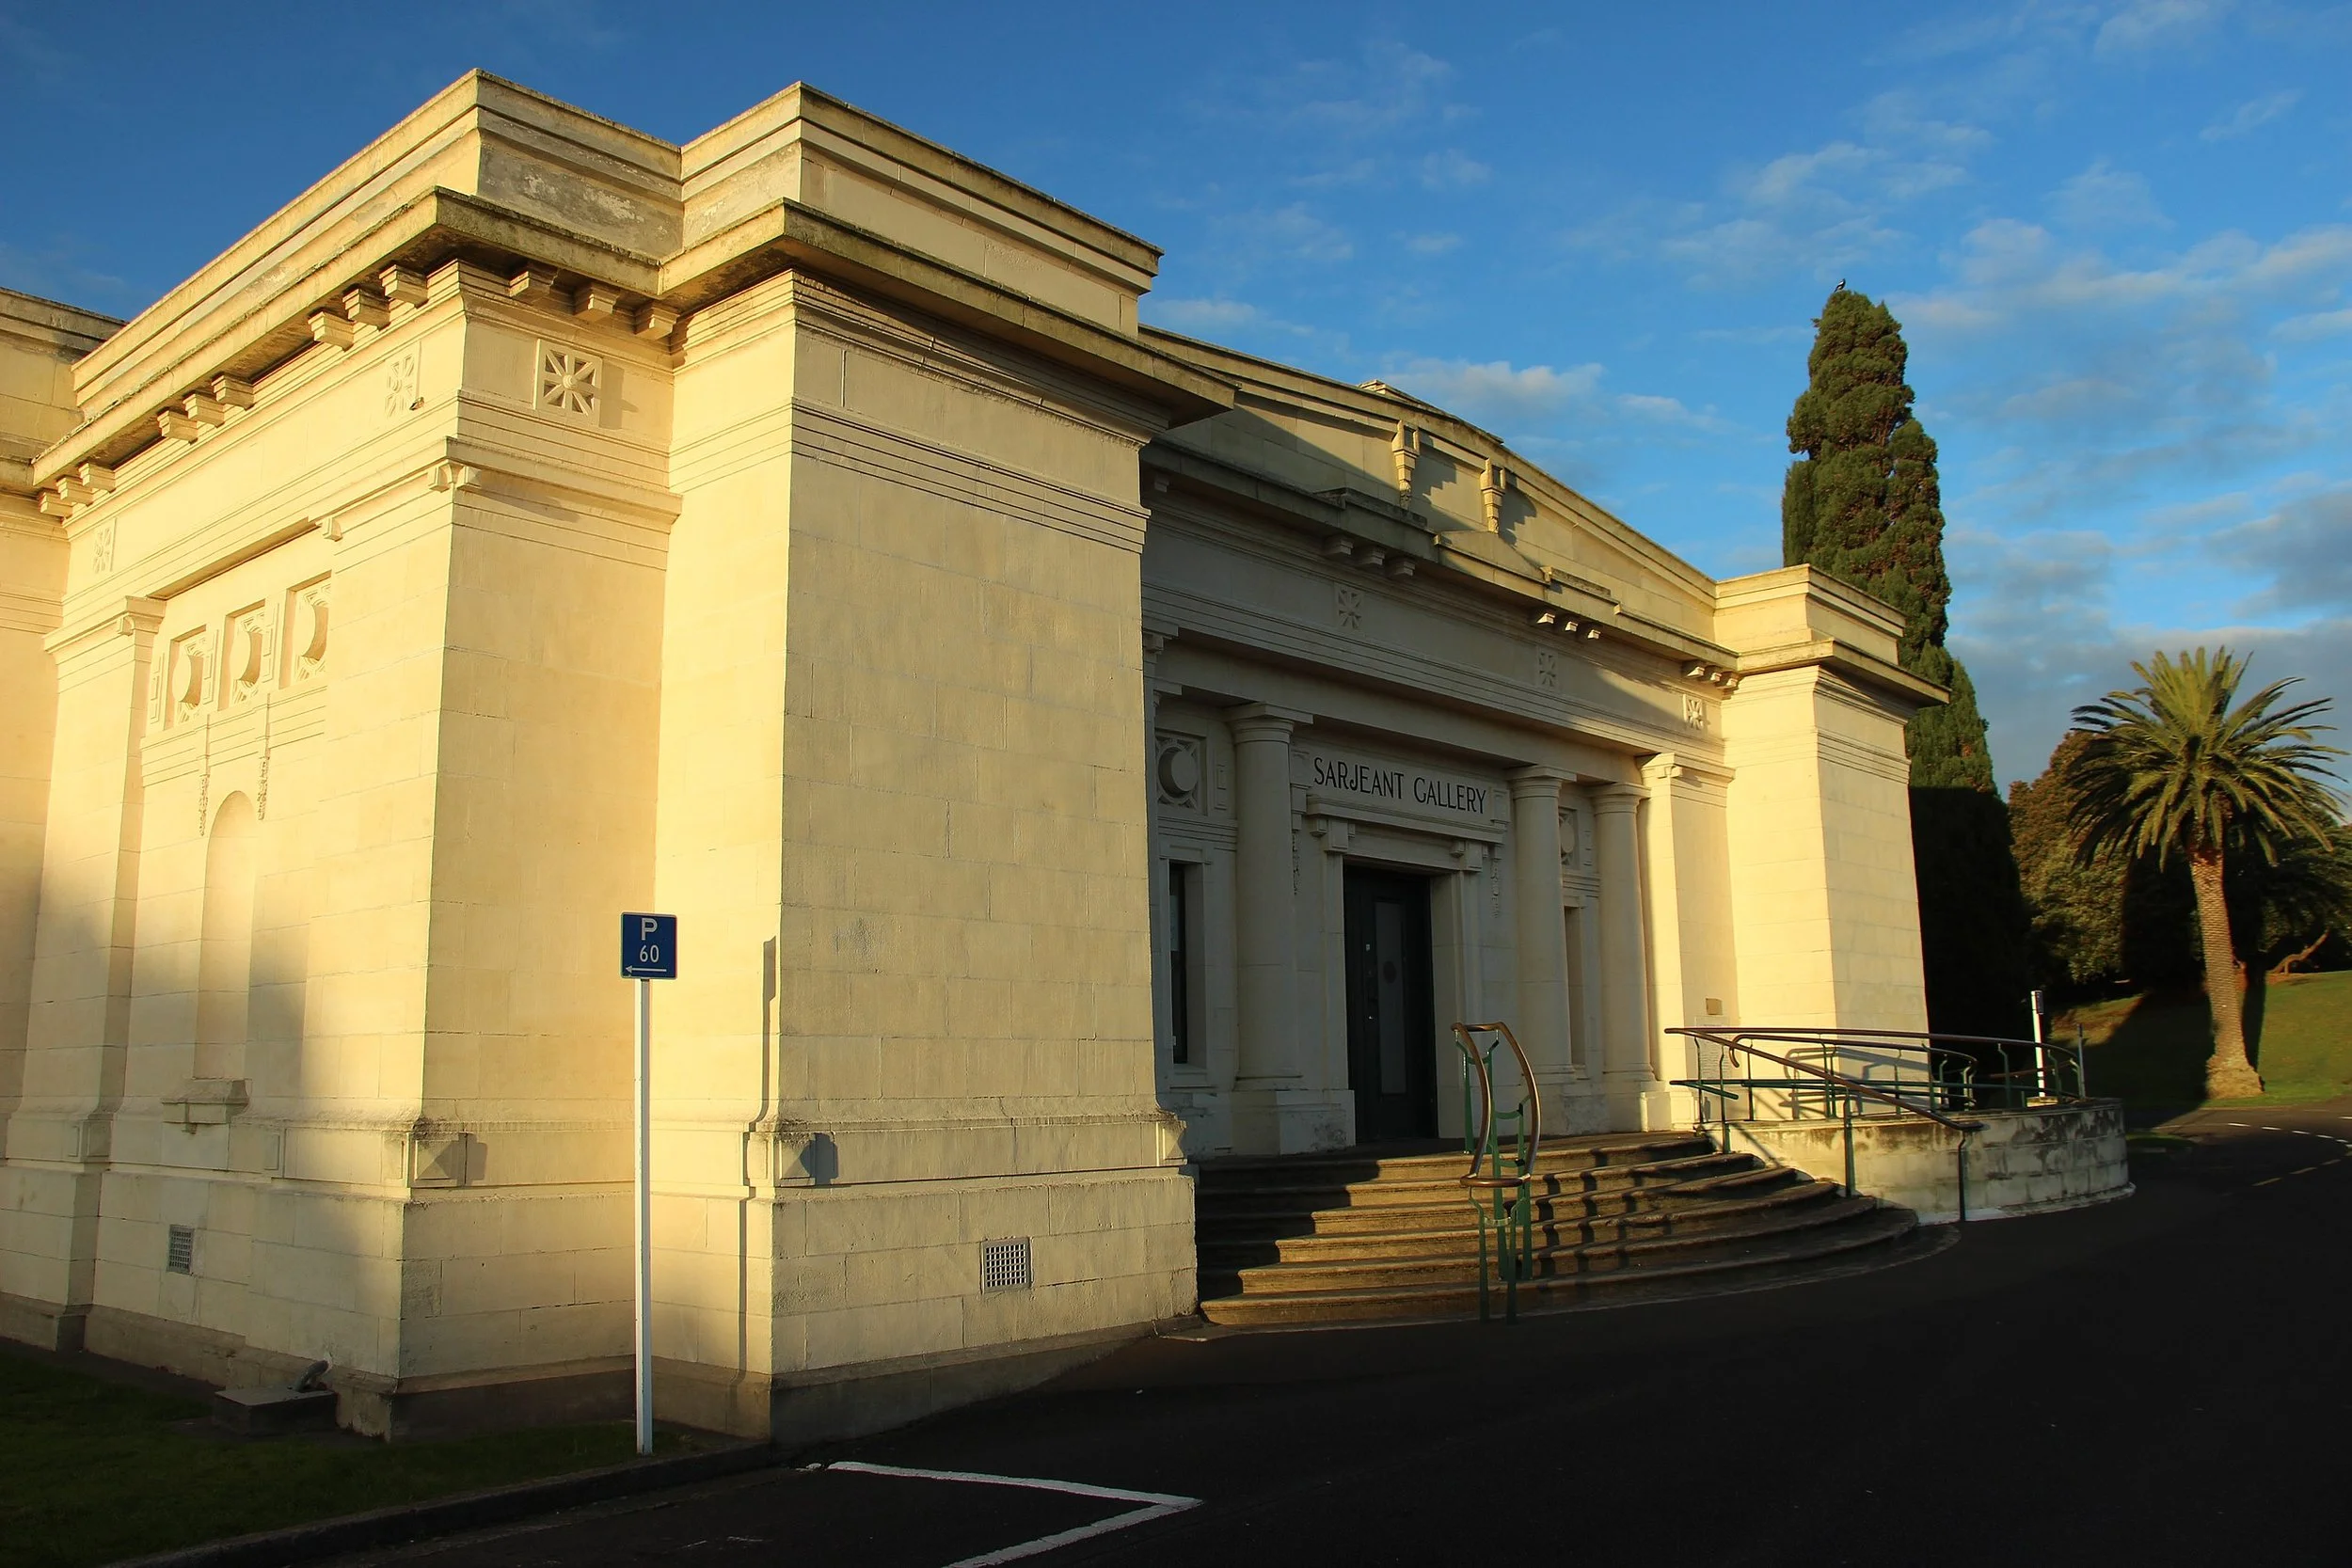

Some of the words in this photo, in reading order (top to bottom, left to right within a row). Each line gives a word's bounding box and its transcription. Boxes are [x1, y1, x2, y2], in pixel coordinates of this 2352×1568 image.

[1313, 756, 1404, 800] SARJEANT
[1414, 777, 1486, 814] GALLERY
[641, 917, 658, 941] P
[640, 944, 660, 963] 60
